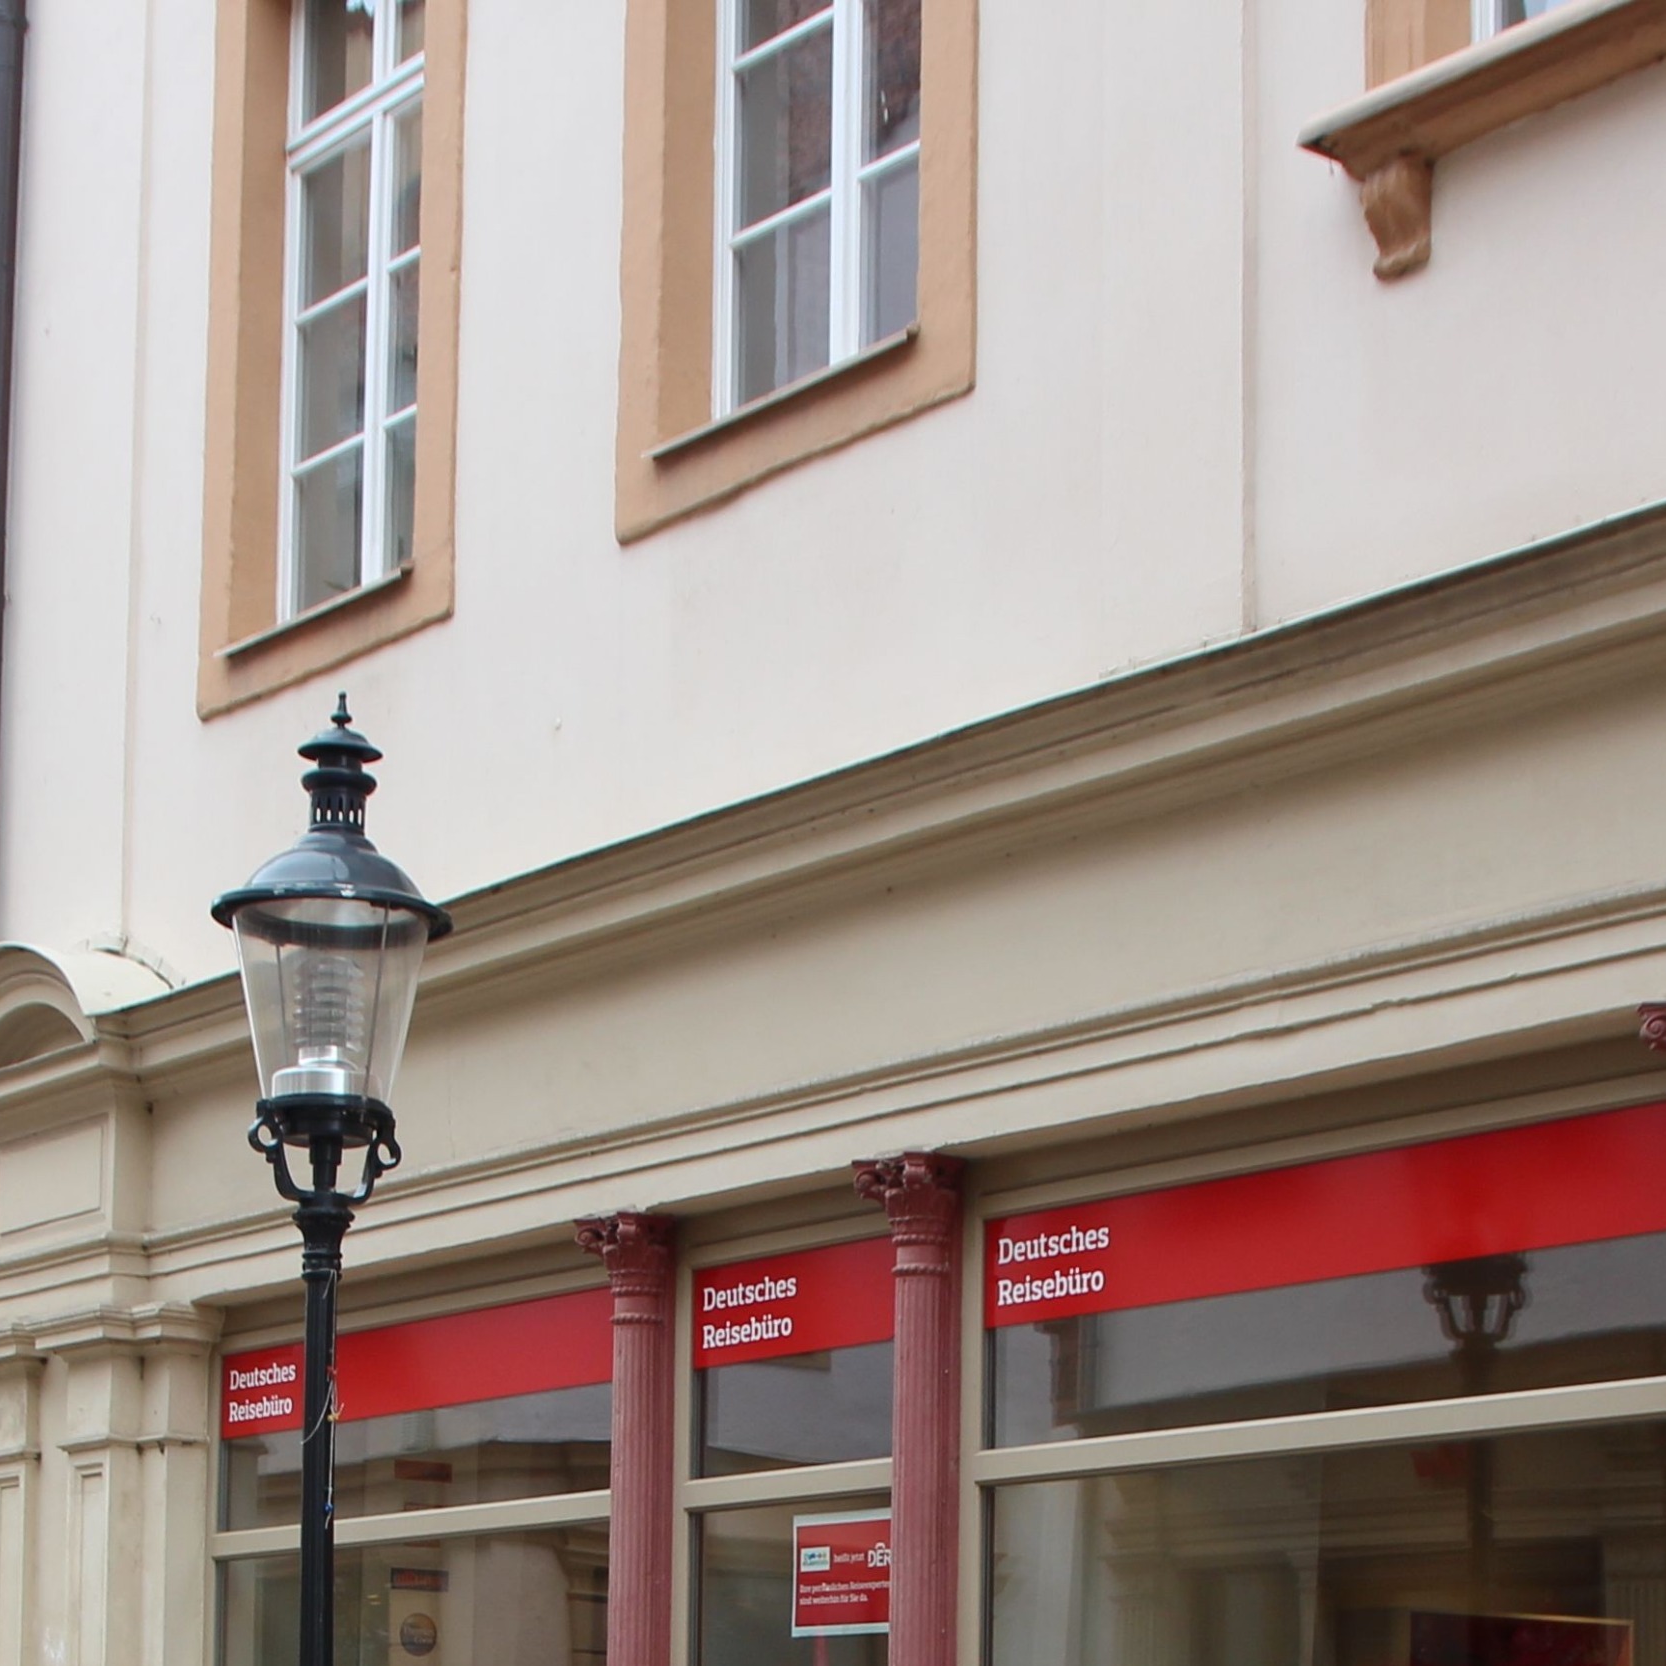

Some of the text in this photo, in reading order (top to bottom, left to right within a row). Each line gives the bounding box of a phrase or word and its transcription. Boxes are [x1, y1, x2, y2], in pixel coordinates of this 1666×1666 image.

[998, 1225, 1109, 1265] Deutsches
[703, 1276, 797, 1311] Deutsches
[998, 1267, 1104, 1306] Reisebüro
[702, 1314, 792, 1349] Reisebüro
[229, 1362, 296, 1391] Deutsches
[228, 1394, 293, 1423] Reisebüro
[867, 1541, 892, 1568] DER
